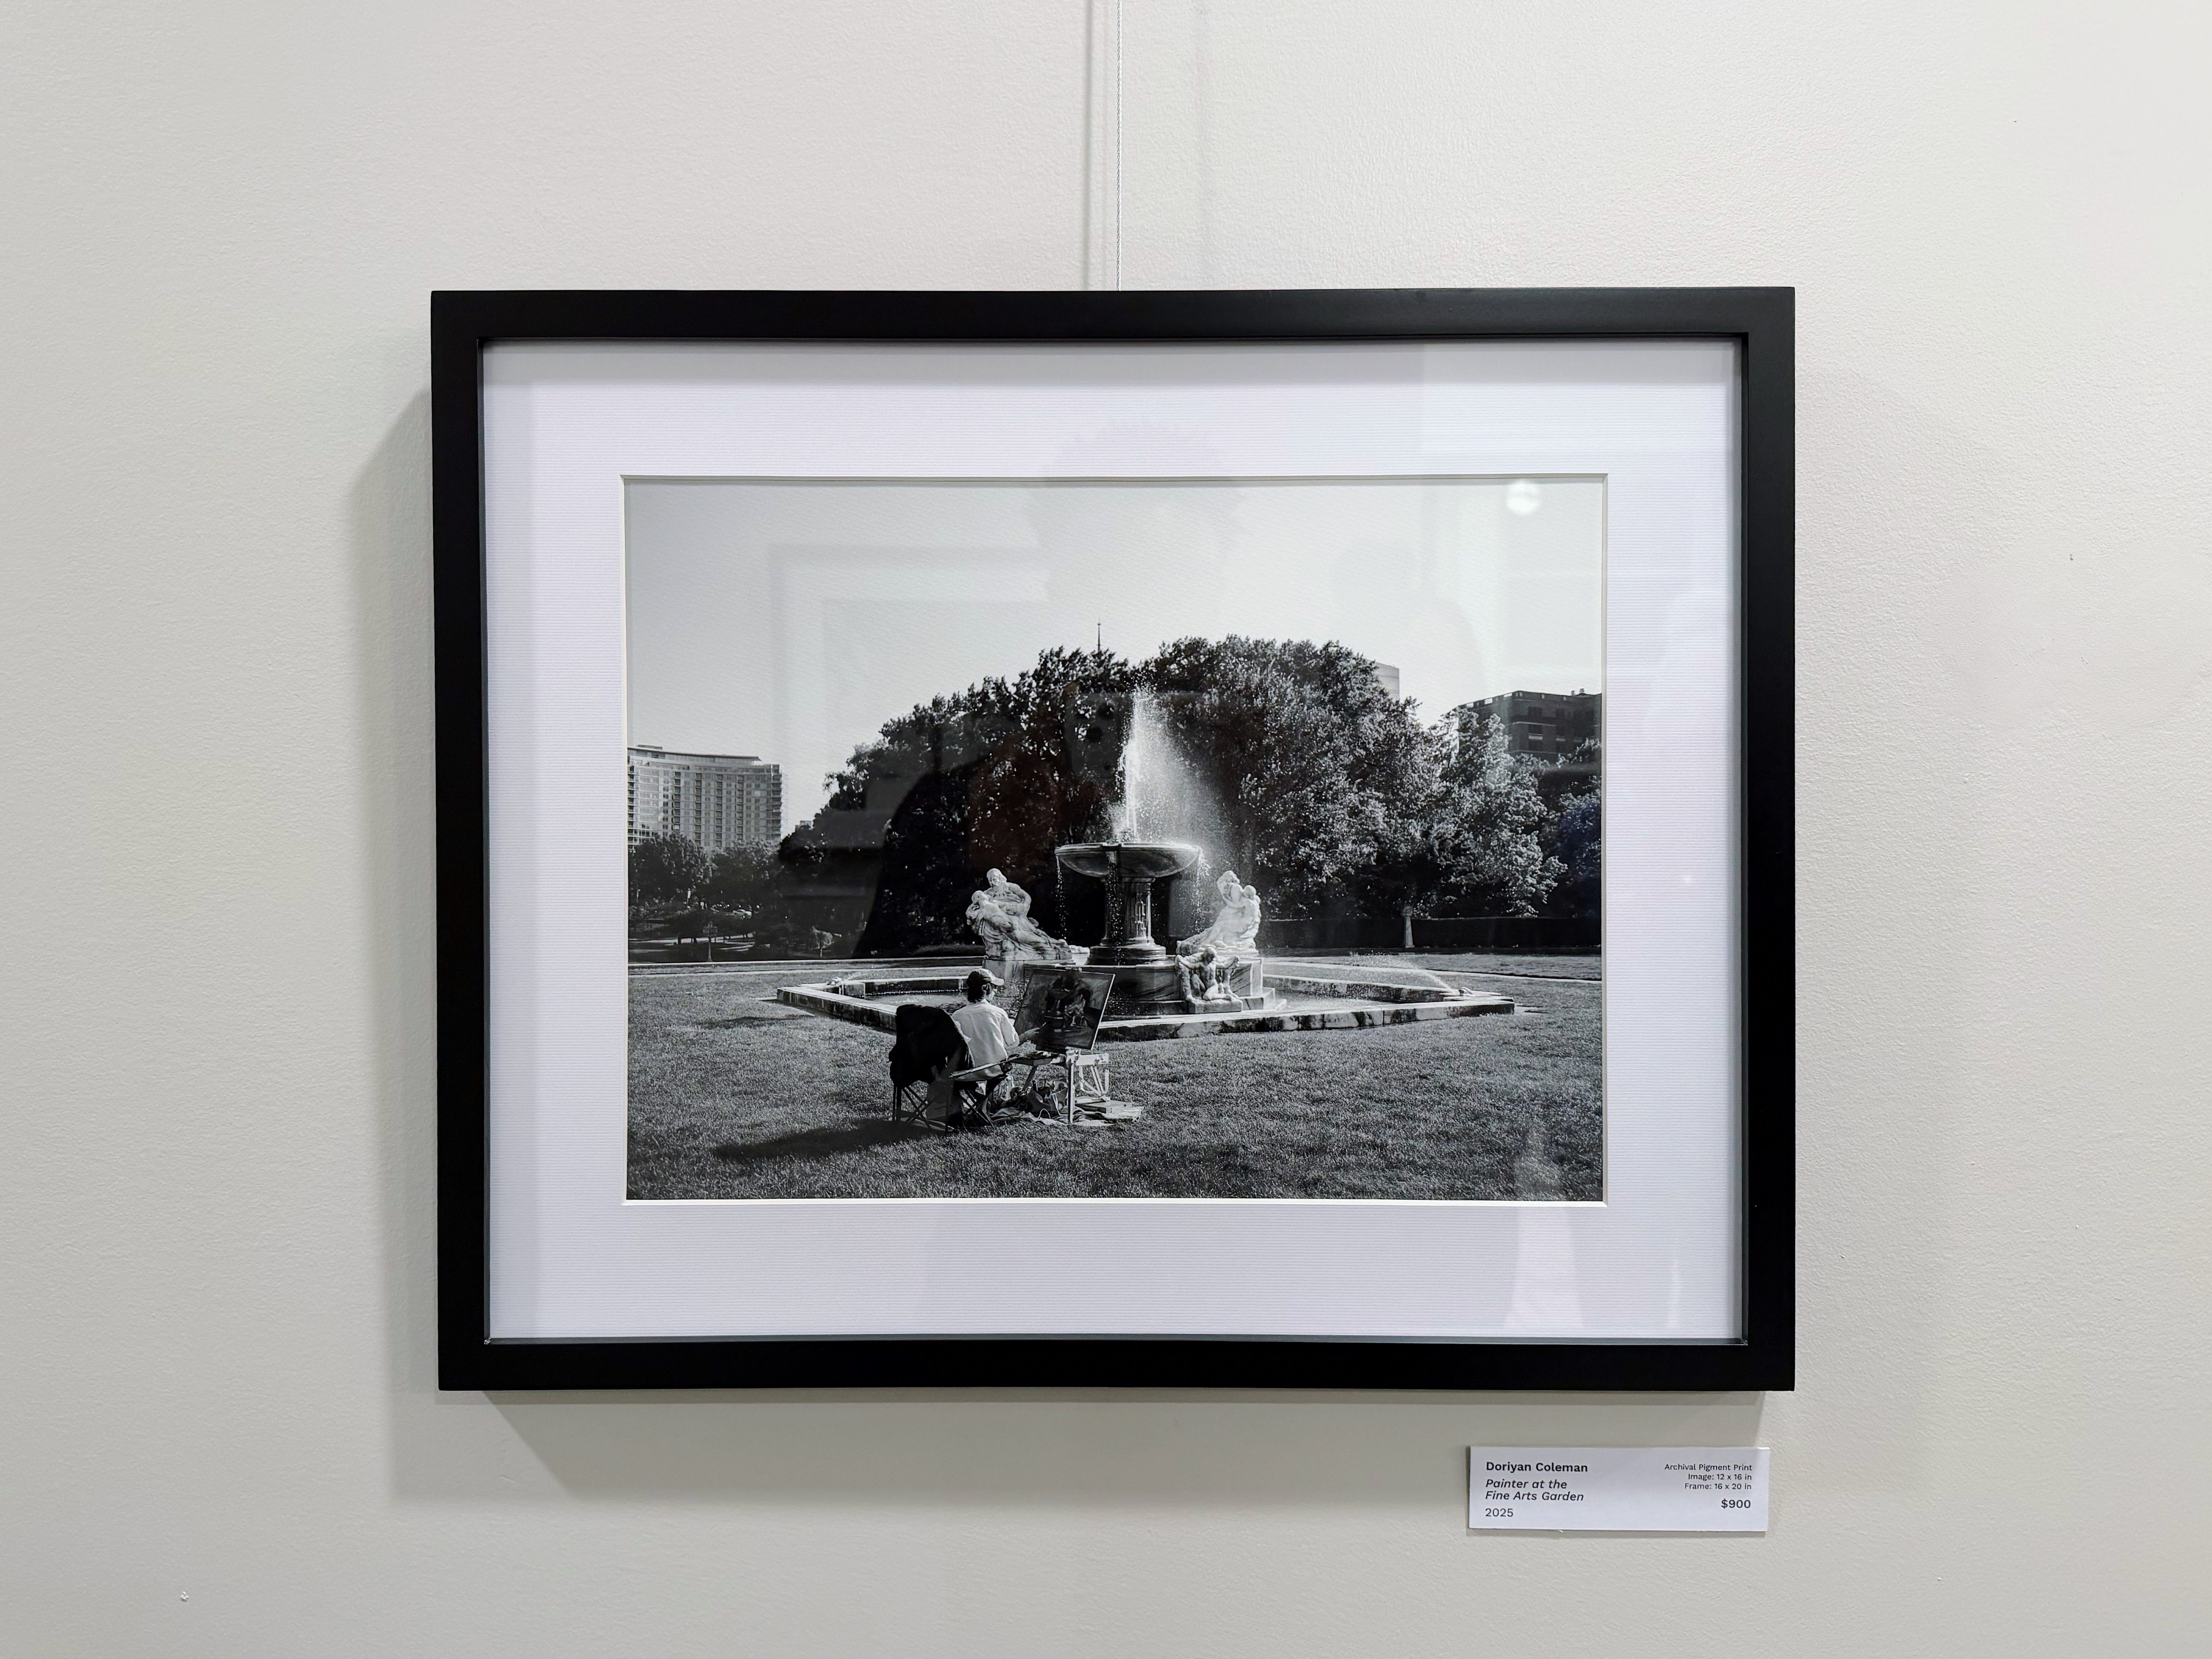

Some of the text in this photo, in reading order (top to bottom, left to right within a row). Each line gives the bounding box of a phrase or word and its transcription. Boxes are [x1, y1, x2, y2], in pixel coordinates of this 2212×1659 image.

[1486, 1462, 1588, 1474] Doriyan Coleman
[1699, 1464, 1731, 1472] Pigment
[1688, 1473, 1715, 1482] Image:
[1485, 1478, 1567, 1489] Painter at the
[1485, 1490, 1584, 1501] Fine Arts Garden
[1721, 1498, 1751, 1509] $900
[1485, 1508, 1513, 1517] 2025
